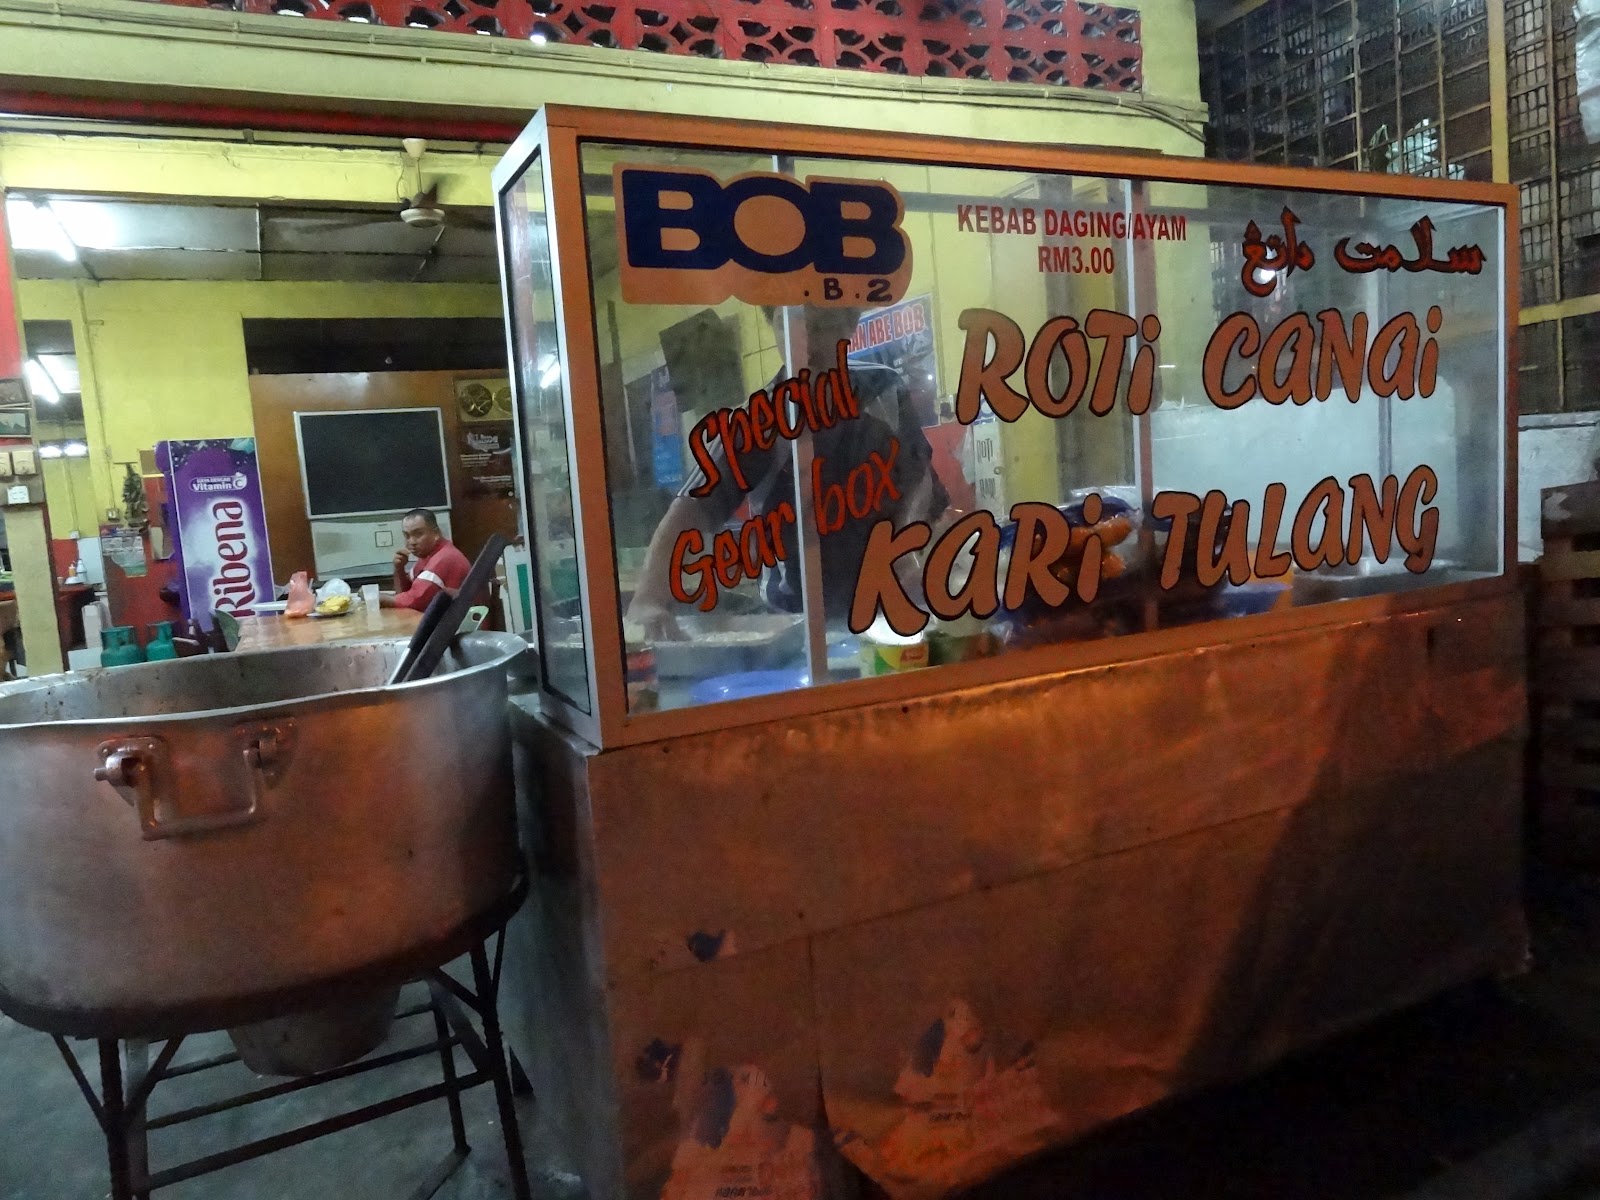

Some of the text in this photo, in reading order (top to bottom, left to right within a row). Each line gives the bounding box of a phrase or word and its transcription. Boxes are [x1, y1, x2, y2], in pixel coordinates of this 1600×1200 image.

[621, 169, 906, 275] BOB
[957, 204, 1037, 236] KEBAB
[1037, 246, 1115, 274] RM3.00
[867, 316, 893, 348] ABE
[892, 303, 926, 340] BOB
[688, 338, 860, 498] Special
[192, 482, 233, 491] Vitamin
[212, 501, 256, 618] Ribena
[669, 437, 903, 612] Gear box
